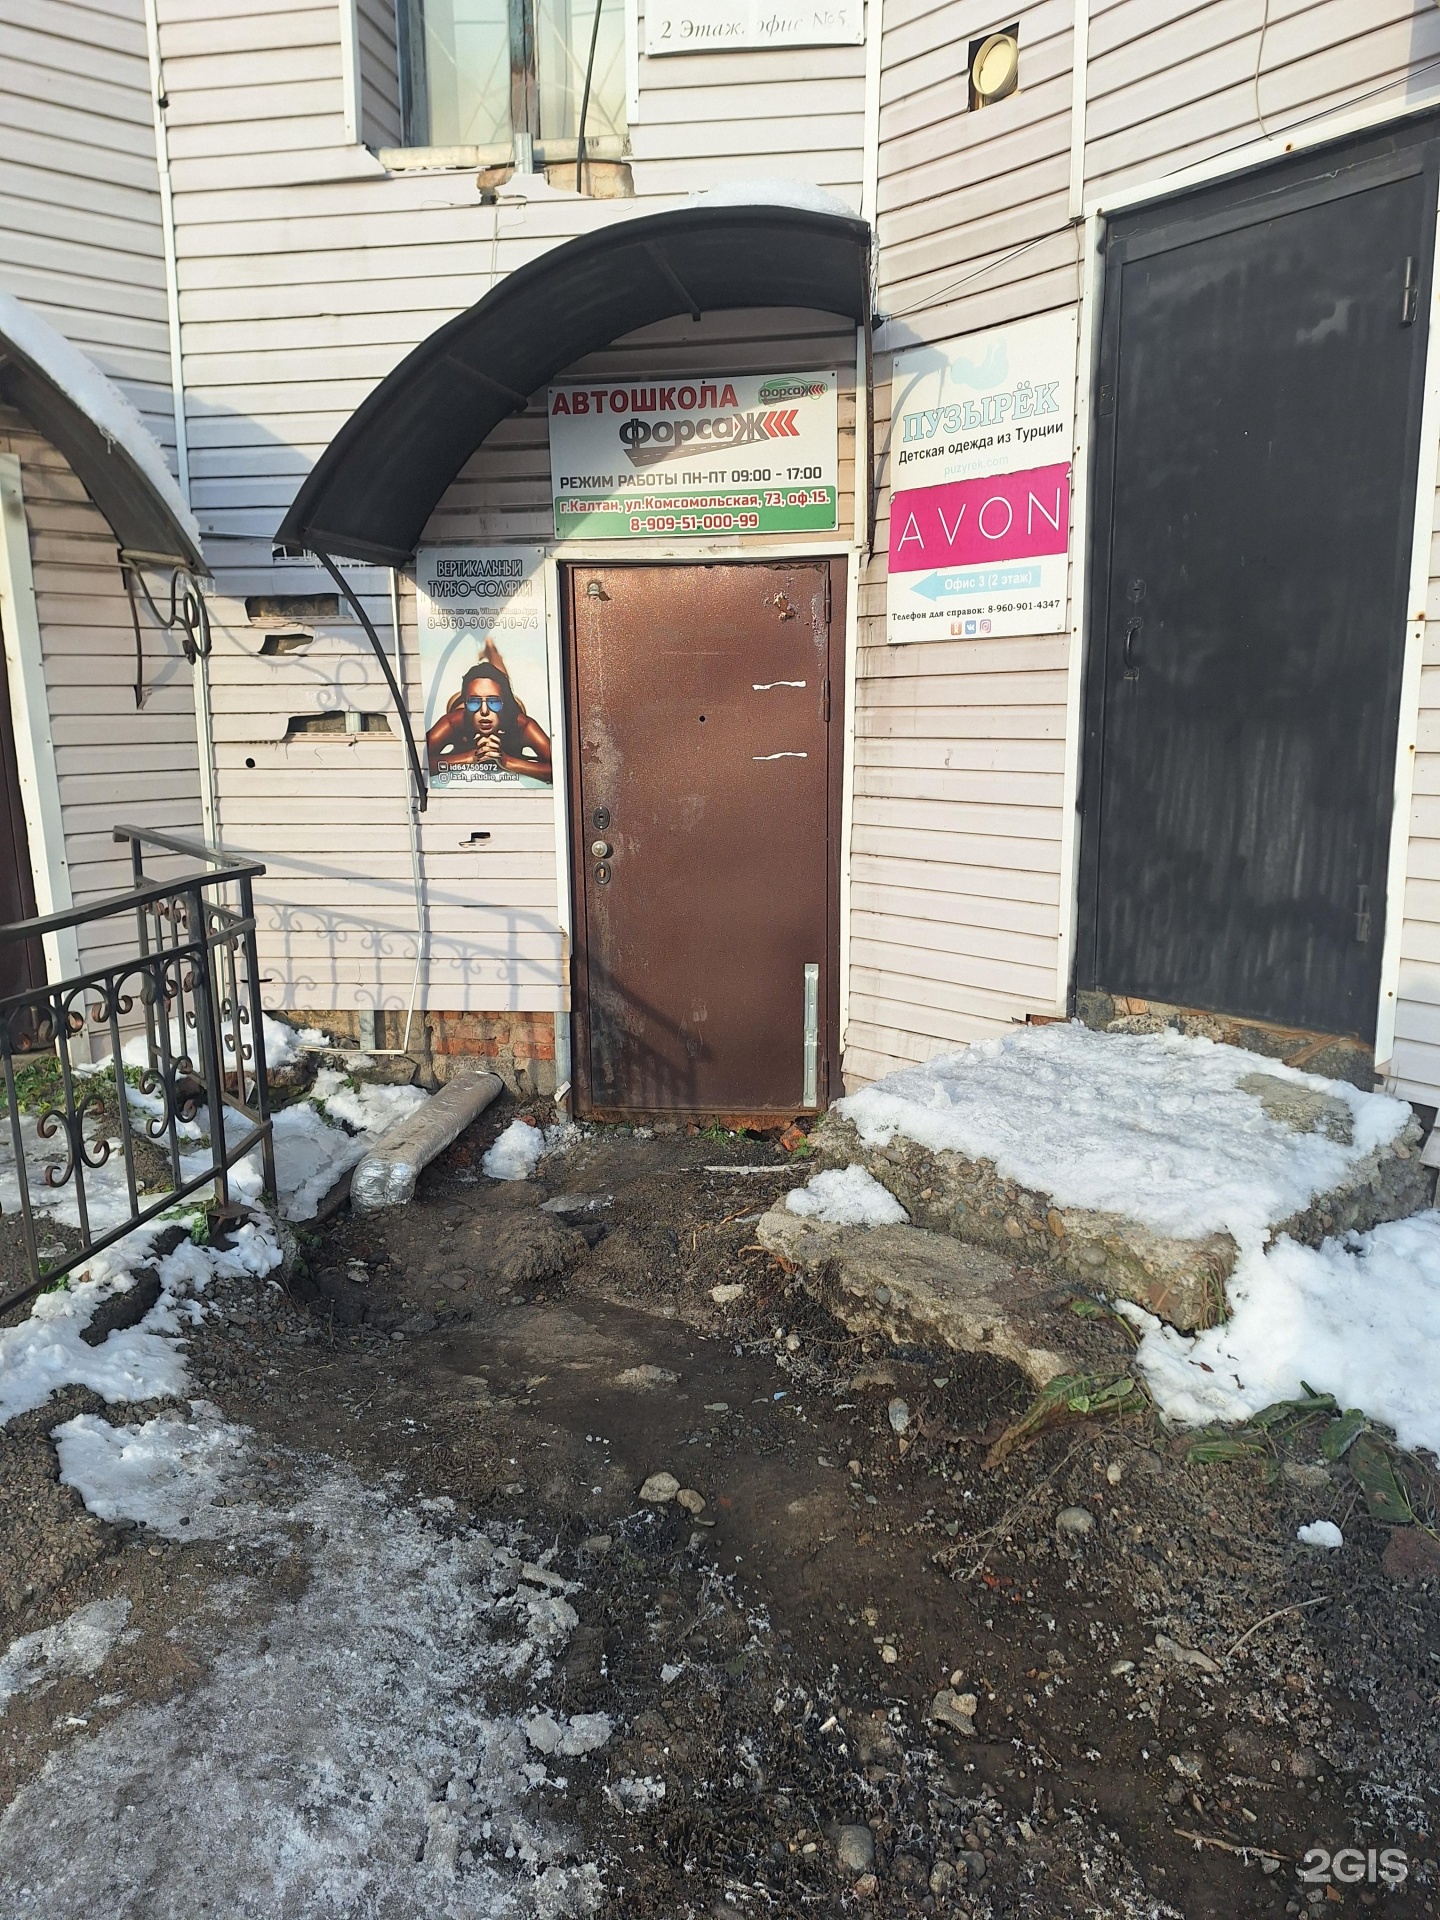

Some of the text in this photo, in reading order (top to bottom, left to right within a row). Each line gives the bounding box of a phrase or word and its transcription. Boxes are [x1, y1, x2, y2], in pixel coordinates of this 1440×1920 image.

[660, 20, 672, 39] 2
[551, 384, 739, 416] АВТОШКОЛА
[902, 380, 1060, 443] ПУЗЫРЁК
[898, 421, 1064, 466] Детская одежда из Турции
[943, 454, 1009, 478] puzyrek.com
[560, 475, 614, 489] РЕЖИМ
[618, 473, 678, 488] РАБОТЫ
[682, 470, 727, 485] ПН-ПТ
[731, 468, 771, 483] 09:00
[786, 466, 822, 481] 17:00
[559, 490, 830, 514] г.Калтан, ул.Комсомольская, 73, оф.15.
[630, 513, 759, 532] 8-909-51-000-99
[897, 487, 1061, 552] AVON
[437, 559, 522, 577] ВЕРТИКАЛЬНЫЙ
[428, 580, 533, 597] ТУРБО-СОЛЯРИЙ
[944, 570, 1032, 592] Офис 3 (2 этаж)
[892, 600, 1060, 622] Телефон для справок: 8-960-901-4347
[427, 616, 538, 629] 8-960-906-10-74
